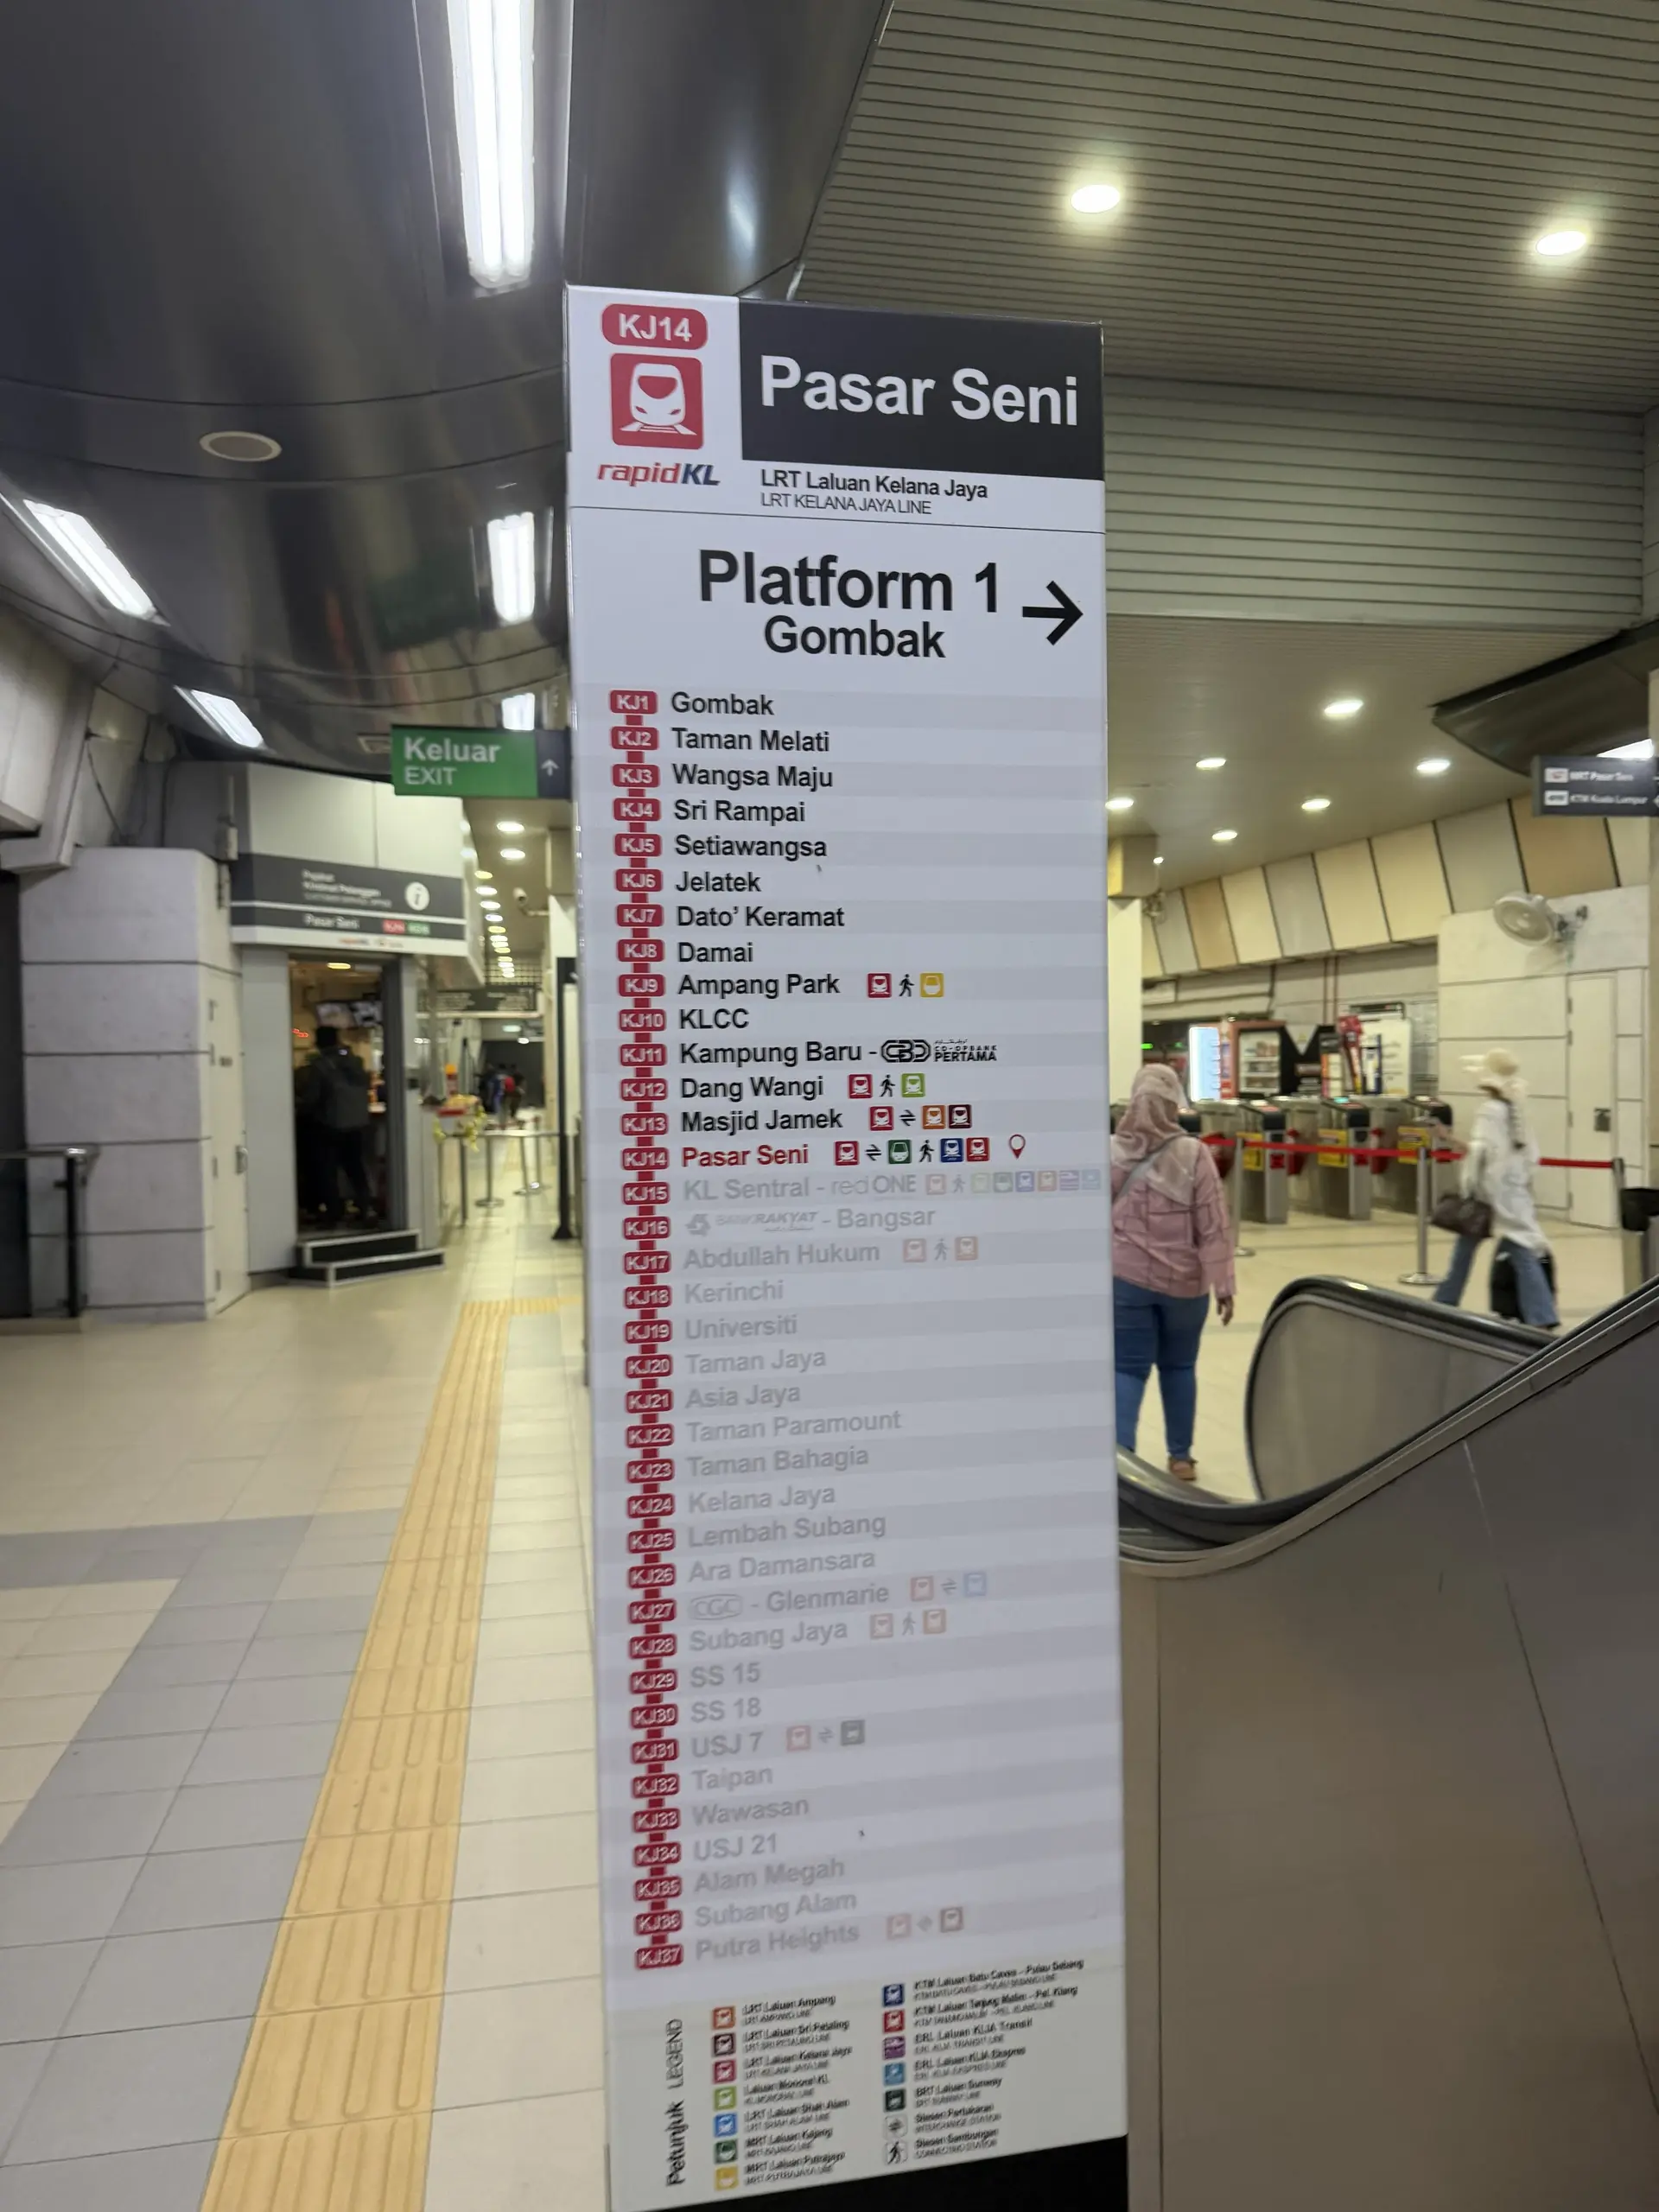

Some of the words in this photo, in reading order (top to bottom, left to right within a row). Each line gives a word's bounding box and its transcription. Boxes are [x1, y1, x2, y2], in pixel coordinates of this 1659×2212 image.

[619, 313, 691, 342] KJ14
[761, 355, 935, 415] Pasar
[952, 368, 1078, 426] Seni
[597, 462, 720, 486] rapidKL
[761, 469, 801, 489] LRT
[806, 471, 870, 493] Laluan
[875, 475, 940, 496] Kelana
[944, 480, 988, 499] Jaya
[761, 493, 791, 508] LRT
[794, 494, 856, 511] KELANA
[859, 498, 895, 512] JAYA
[898, 499, 931, 515] LINE
[700, 550, 953, 611] Platform
[975, 563, 997, 612] 1
[764, 615, 946, 658] Gombak
[617, 696, 650, 710] KJ1
[671, 692, 774, 715] Gombak
[404, 737, 501, 763] Keluar
[619, 732, 652, 747] KJ2
[672, 728, 752, 750] Taman
[760, 730, 830, 753] Melati
[404, 767, 456, 785] EXIT
[620, 768, 652, 784] KJ3
[673, 764, 770, 790] Wangsa
[779, 766, 833, 791] Maju
[620, 803, 654, 817] KJ4
[674, 799, 708, 821] Sri
[715, 800, 805, 825] Rampai
[621, 838, 655, 853] KJ5
[675, 835, 827, 861] Setiawangsa
[623, 874, 656, 888] KJ6
[676, 871, 760, 893] Jelatek
[624, 908, 656, 923] KJ7
[745, 906, 844, 927] Keramat
[625, 943, 658, 958] KJ8
[678, 942, 753, 963] Damai
[626, 978, 658, 993] KJ9
[678, 976, 779, 999] Ampang
[786, 974, 840, 994] Park
[621, 1014, 664, 1029] KJ10
[679, 1008, 749, 1031] KLCC
[623, 1047, 664, 1063] KJ11
[680, 1043, 798, 1067] Kampung
[806, 1042, 862, 1062] Baru
[934, 1052, 998, 1063] PERTAMA
[624, 1083, 665, 1098] KJ12
[681, 1078, 743, 1102] Dang
[749, 1076, 824, 1100] Wangi
[624, 1116, 666, 1132] KJ13
[682, 1110, 760, 1136] Masjid
[766, 1109, 842, 1129] Jamek
[624, 1152, 666, 1166] KJ14
[683, 1147, 751, 1166] Pasar
[757, 1144, 809, 1165] Seni
[625, 1185, 667, 1201] KJ15
[684, 1179, 717, 1200] KL
[725, 1176, 810, 1198] Sentral
[626, 1220, 668, 1236] KJ16
[837, 1208, 935, 1230] Bangsar
[626, 1255, 669, 1270] KJ17
[683, 1246, 790, 1269] Abdullah
[798, 1243, 880, 1263] Hukum
[626, 1290, 669, 1306] KJ18
[685, 1280, 784, 1302] Kerinchi
[627, 1325, 670, 1339] KJ19
[686, 1314, 797, 1338] Universiti
[627, 1358, 671, 1374] KJ20
[685, 1351, 765, 1375] Taman
[771, 1349, 827, 1372] Jaya
[627, 1393, 670, 1408] KJ21
[685, 1389, 739, 1408] Asia
[746, 1385, 801, 1408] Jaya
[628, 1427, 671, 1443] KJ22
[687, 1420, 766, 1442] Taman
[773, 1410, 902, 1436] Paramount
[629, 1462, 672, 1478] KJ23
[688, 1454, 766, 1477] Taman
[774, 1447, 869, 1472] Bahagia
[629, 1497, 672, 1513] KJ24
[689, 1491, 771, 1513] Kelana
[780, 1485, 836, 1510] Jaya
[631, 1532, 673, 1548] KJ25
[690, 1522, 786, 1548] Lembah
[794, 1515, 886, 1541] Subang
[631, 1567, 674, 1583] KJ26
[689, 1561, 731, 1582] Ara
[740, 1552, 875, 1579] Damansara
[767, 1583, 889, 1612] Glenmarie
[690, 1627, 783, 1651] Subang
[792, 1618, 848, 1644] Jaya
[690, 1666, 725, 1687] SS
[733, 1663, 760, 1684] 15
[691, 1700, 725, 1722] SS
[734, 1698, 761, 1719] 18
[693, 1735, 742, 1758] USJ
[750, 1732, 763, 1753] 7
[692, 1767, 772, 1791] Taipan
[694, 1798, 809, 1826] Wawasan
[694, 1838, 744, 1860] USJ
[752, 1834, 778, 1855] 21
[695, 1872, 757, 1893] Alam
[765, 1859, 845, 1886] Megah
[696, 1904, 789, 1929] Subang
[796, 1892, 856, 1915] Alam
[696, 1937, 760, 1961] Putra
[769, 1923, 860, 1953] Heights
